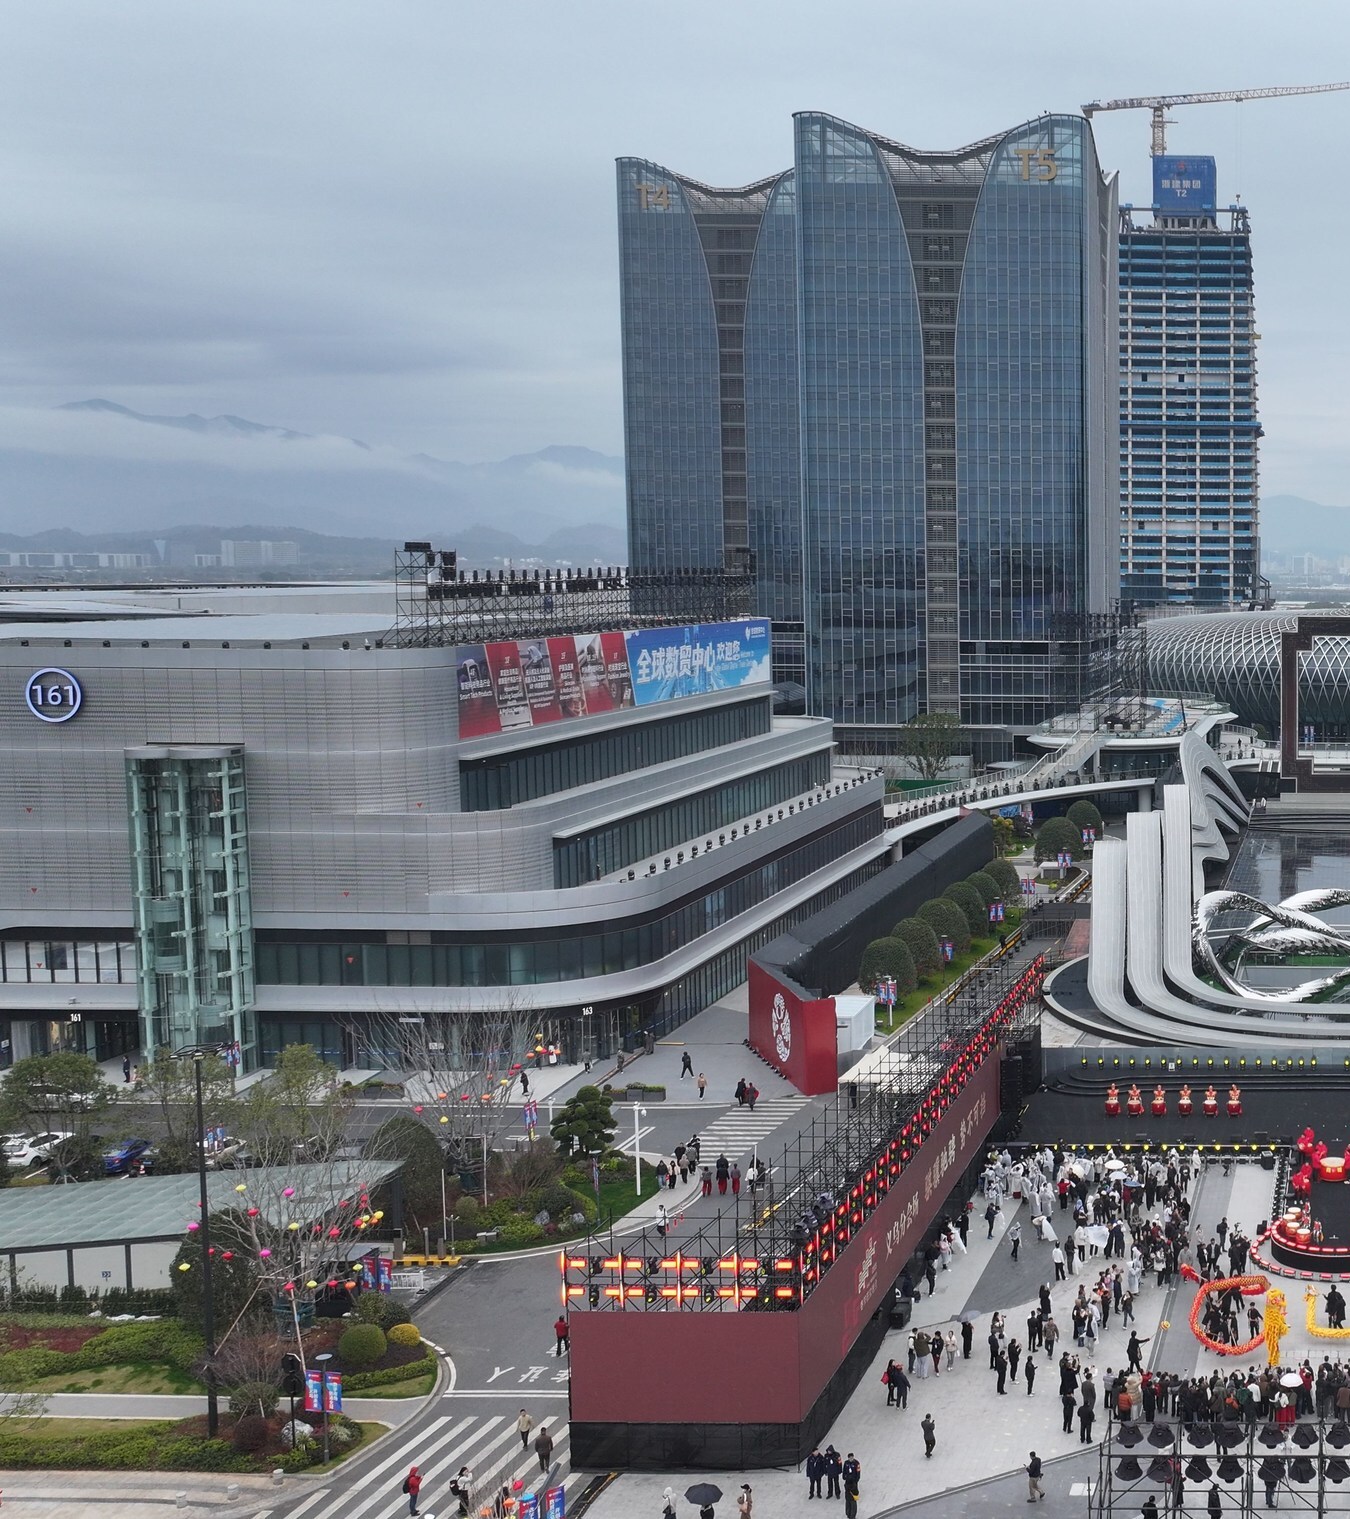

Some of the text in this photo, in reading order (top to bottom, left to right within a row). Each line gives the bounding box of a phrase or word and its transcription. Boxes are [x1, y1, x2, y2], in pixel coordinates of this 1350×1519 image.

[1014, 149, 1056, 181] T5
[635, 184, 670, 210] T4
[637, 642, 716, 684] 全球数贸中心
[717, 640, 740, 661] 欢迎您
[32, 685, 74, 705] 161
[70, 1013, 81, 1021] 161
[582, 1006, 593, 1016] 163
